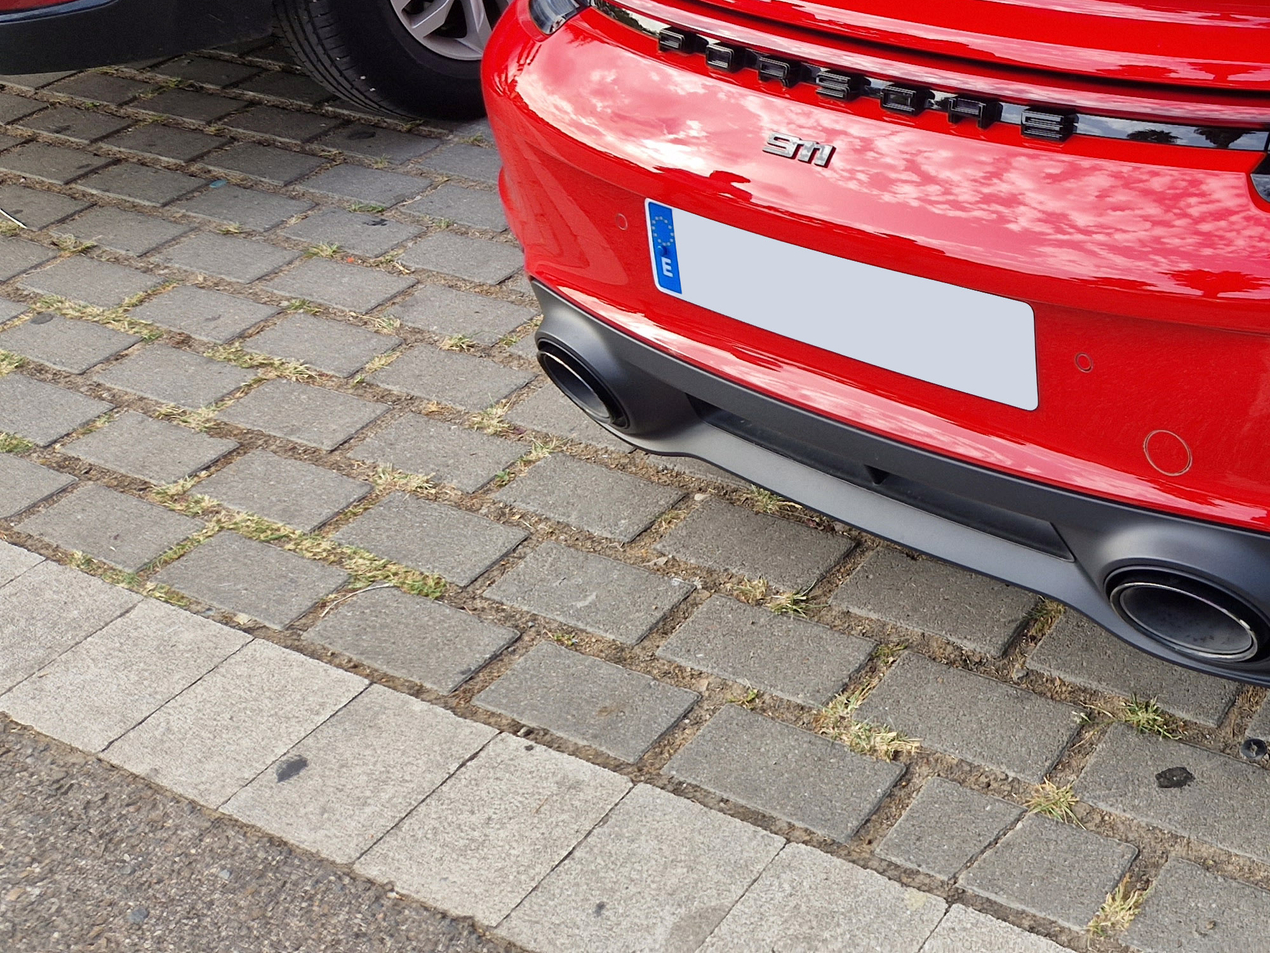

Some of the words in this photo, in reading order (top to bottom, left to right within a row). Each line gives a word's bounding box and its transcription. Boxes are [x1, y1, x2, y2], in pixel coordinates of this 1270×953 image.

[658, 26, 1077, 142] PORSCHE
[762, 132, 837, 169] 911
[661, 256, 674, 278] E
